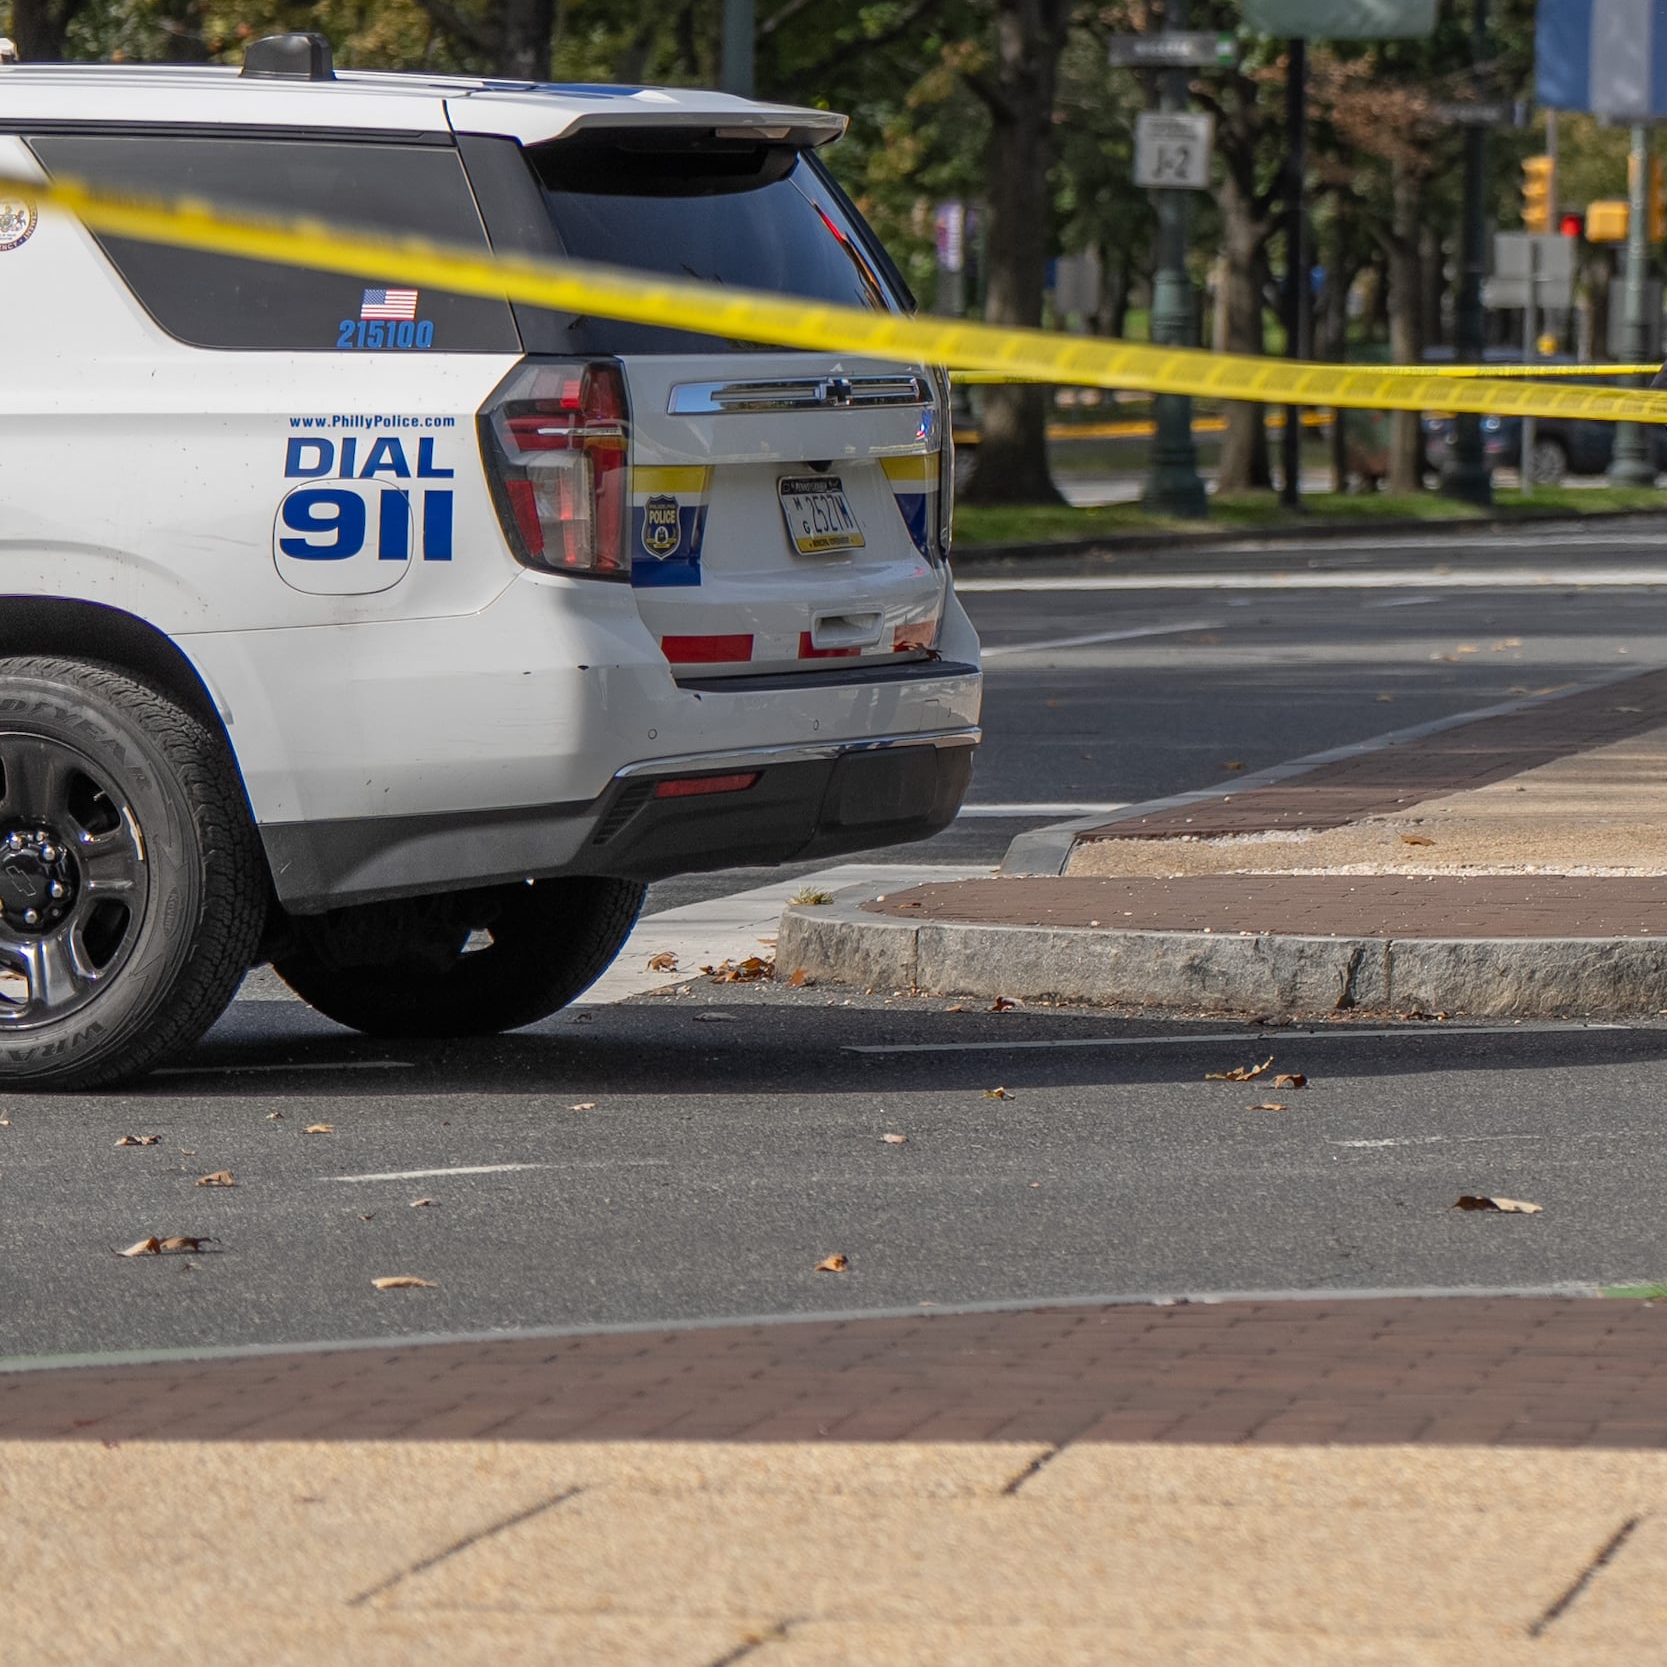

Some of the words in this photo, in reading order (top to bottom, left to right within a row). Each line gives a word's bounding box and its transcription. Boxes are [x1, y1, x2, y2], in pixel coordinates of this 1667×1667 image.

[336, 320, 434, 349] 215100
[289, 415, 456, 430] www.PhillyPolice.com
[284, 437, 455, 478] DIAL
[279, 488, 454, 561] 911
[649, 509, 676, 524] POLICE
